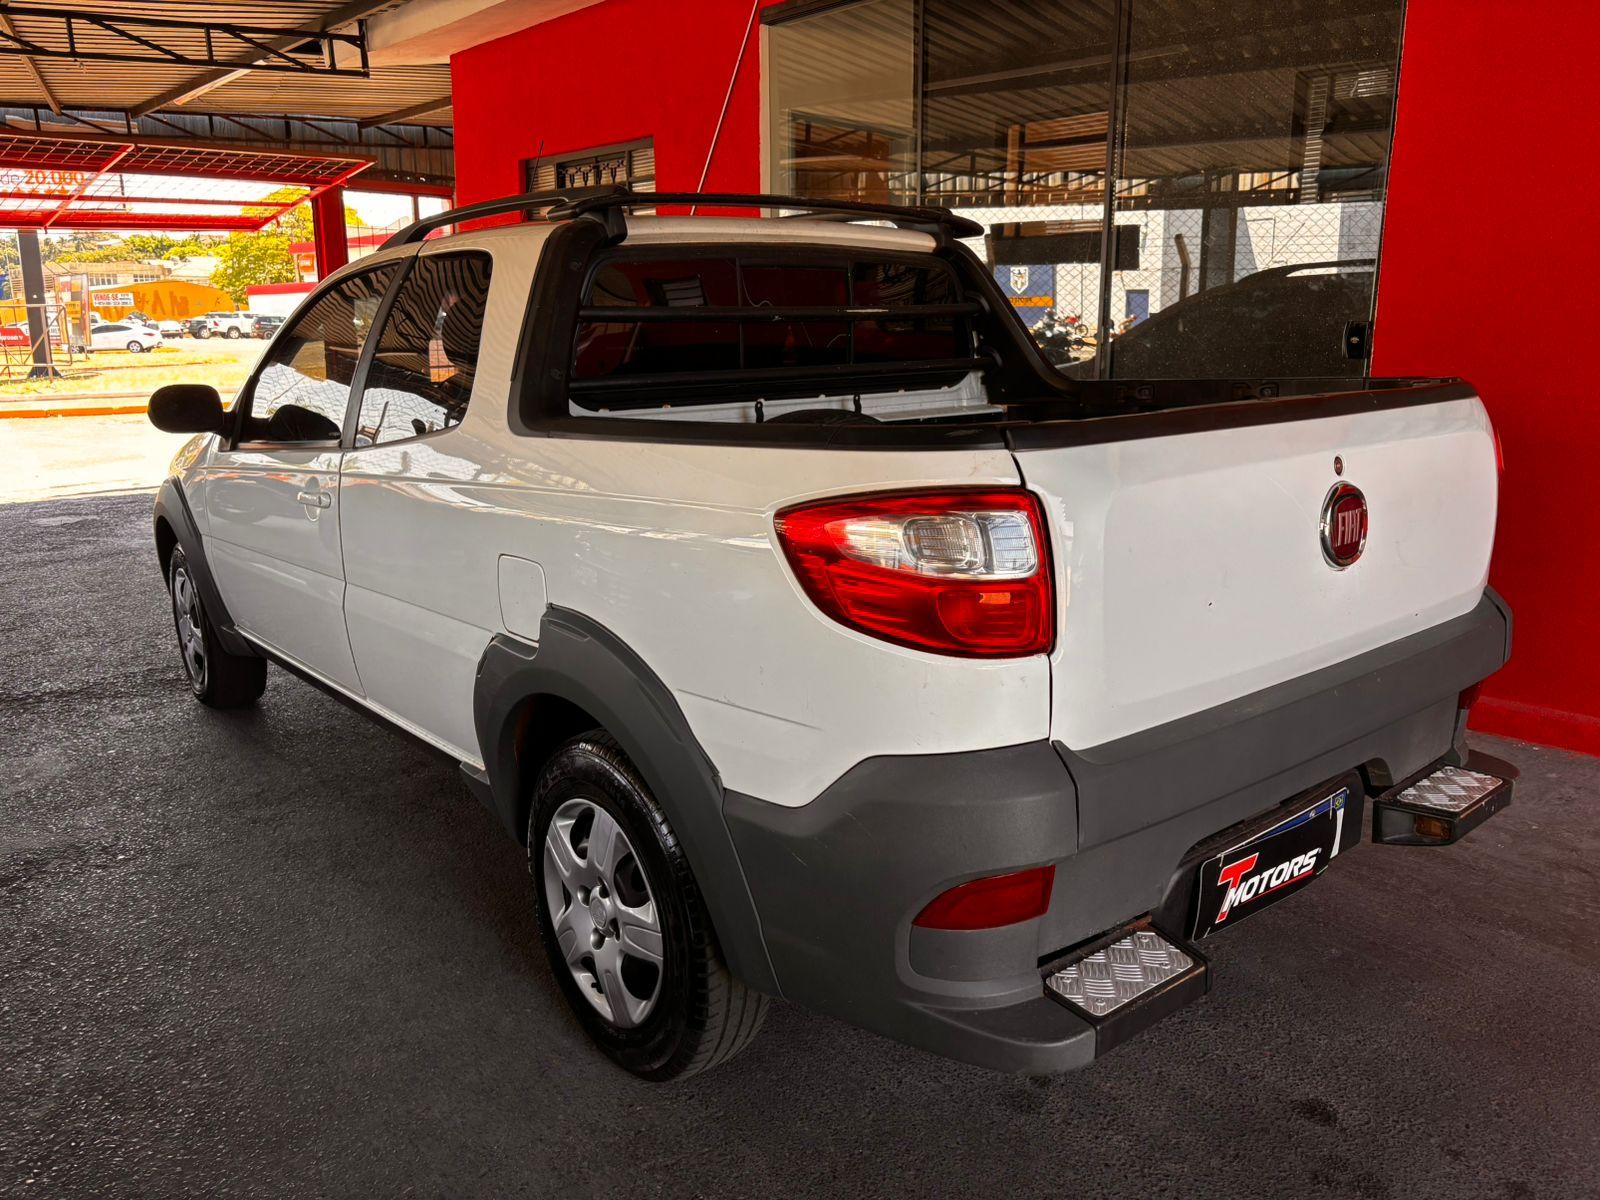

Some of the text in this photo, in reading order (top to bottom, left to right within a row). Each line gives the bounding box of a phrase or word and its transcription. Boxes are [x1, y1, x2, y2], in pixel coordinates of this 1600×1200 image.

[1337, 508, 1362, 547] FIAT
[1215, 848, 1321, 923] T MOTORS
